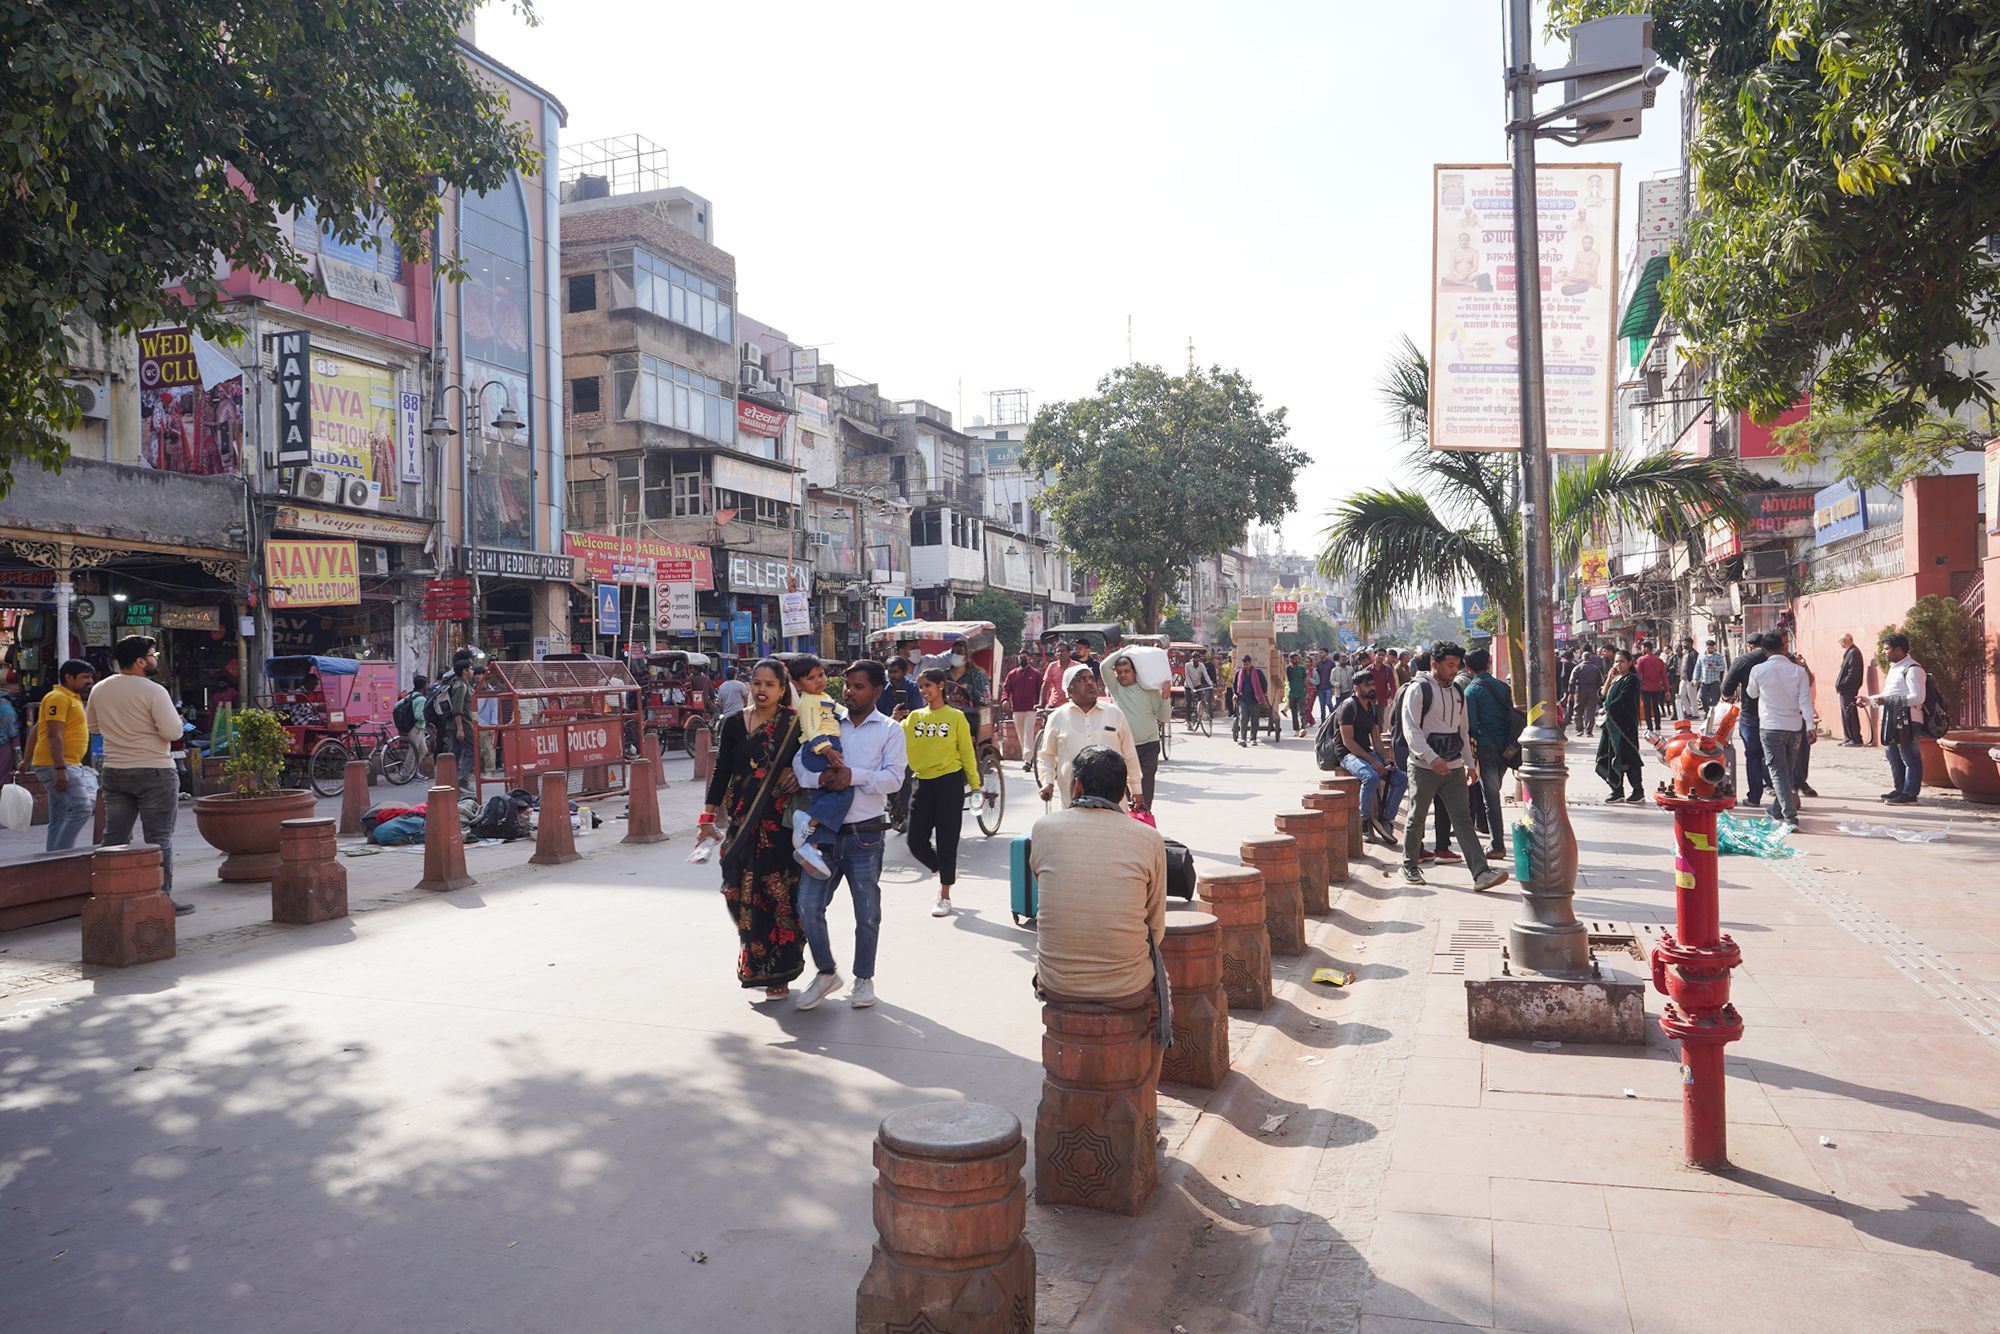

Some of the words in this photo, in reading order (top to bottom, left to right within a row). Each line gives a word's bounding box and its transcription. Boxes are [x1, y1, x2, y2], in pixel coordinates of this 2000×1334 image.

[333, 268, 384, 291] NAVYA
[316, 359, 337, 376] 88
[283, 335, 303, 445] NAVYA
[310, 382, 363, 420] AVYA
[403, 395, 418, 411] 88
[744, 406, 782, 426] शेरवानी
[407, 412, 416, 474] NAVYA
[572, 535, 620, 552] Welcome
[674, 547, 706, 561] KALAN
[269, 546, 354, 580] NAVYA
[499, 553, 540, 574] WEDDING
[542, 557, 569, 577] HOUSE
[290, 582, 355, 603] COLLECTION
[568, 729, 598, 753] POLICE
